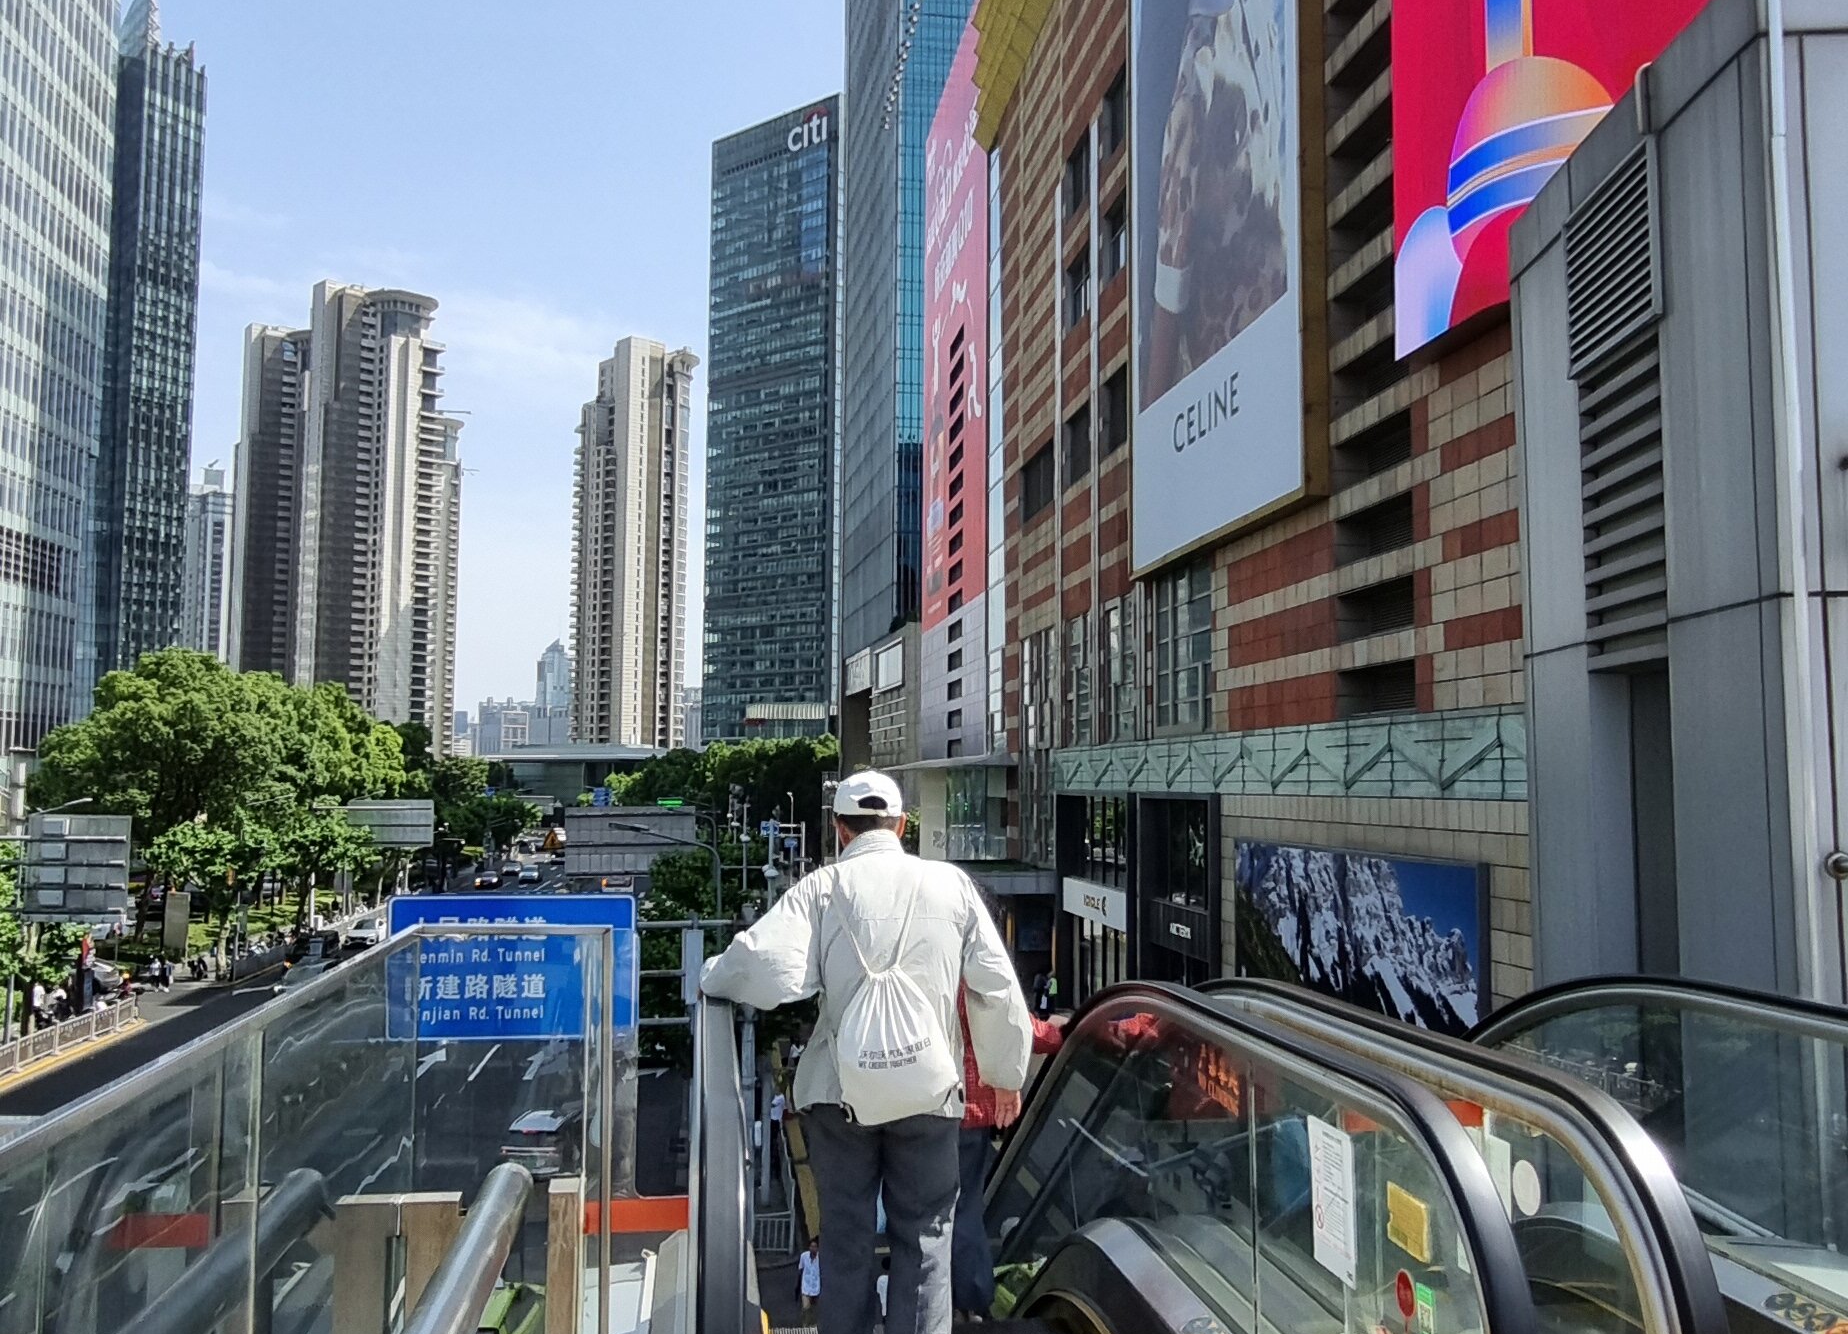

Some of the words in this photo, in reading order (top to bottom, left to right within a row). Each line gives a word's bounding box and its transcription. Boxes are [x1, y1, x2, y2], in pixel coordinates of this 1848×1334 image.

[787, 113, 828, 152] citi
[1173, 371, 1240, 454] CELINE
[405, 948, 465, 964] enmin
[471, 948, 492, 964] Rd.
[497, 948, 546, 963] Tunnel
[405, 973, 547, 1001] 新建路隧道
[409, 1006, 461, 1026] injian
[468, 1006, 490, 1021] Rd.
[495, 1005, 545, 1020] Tunnel
